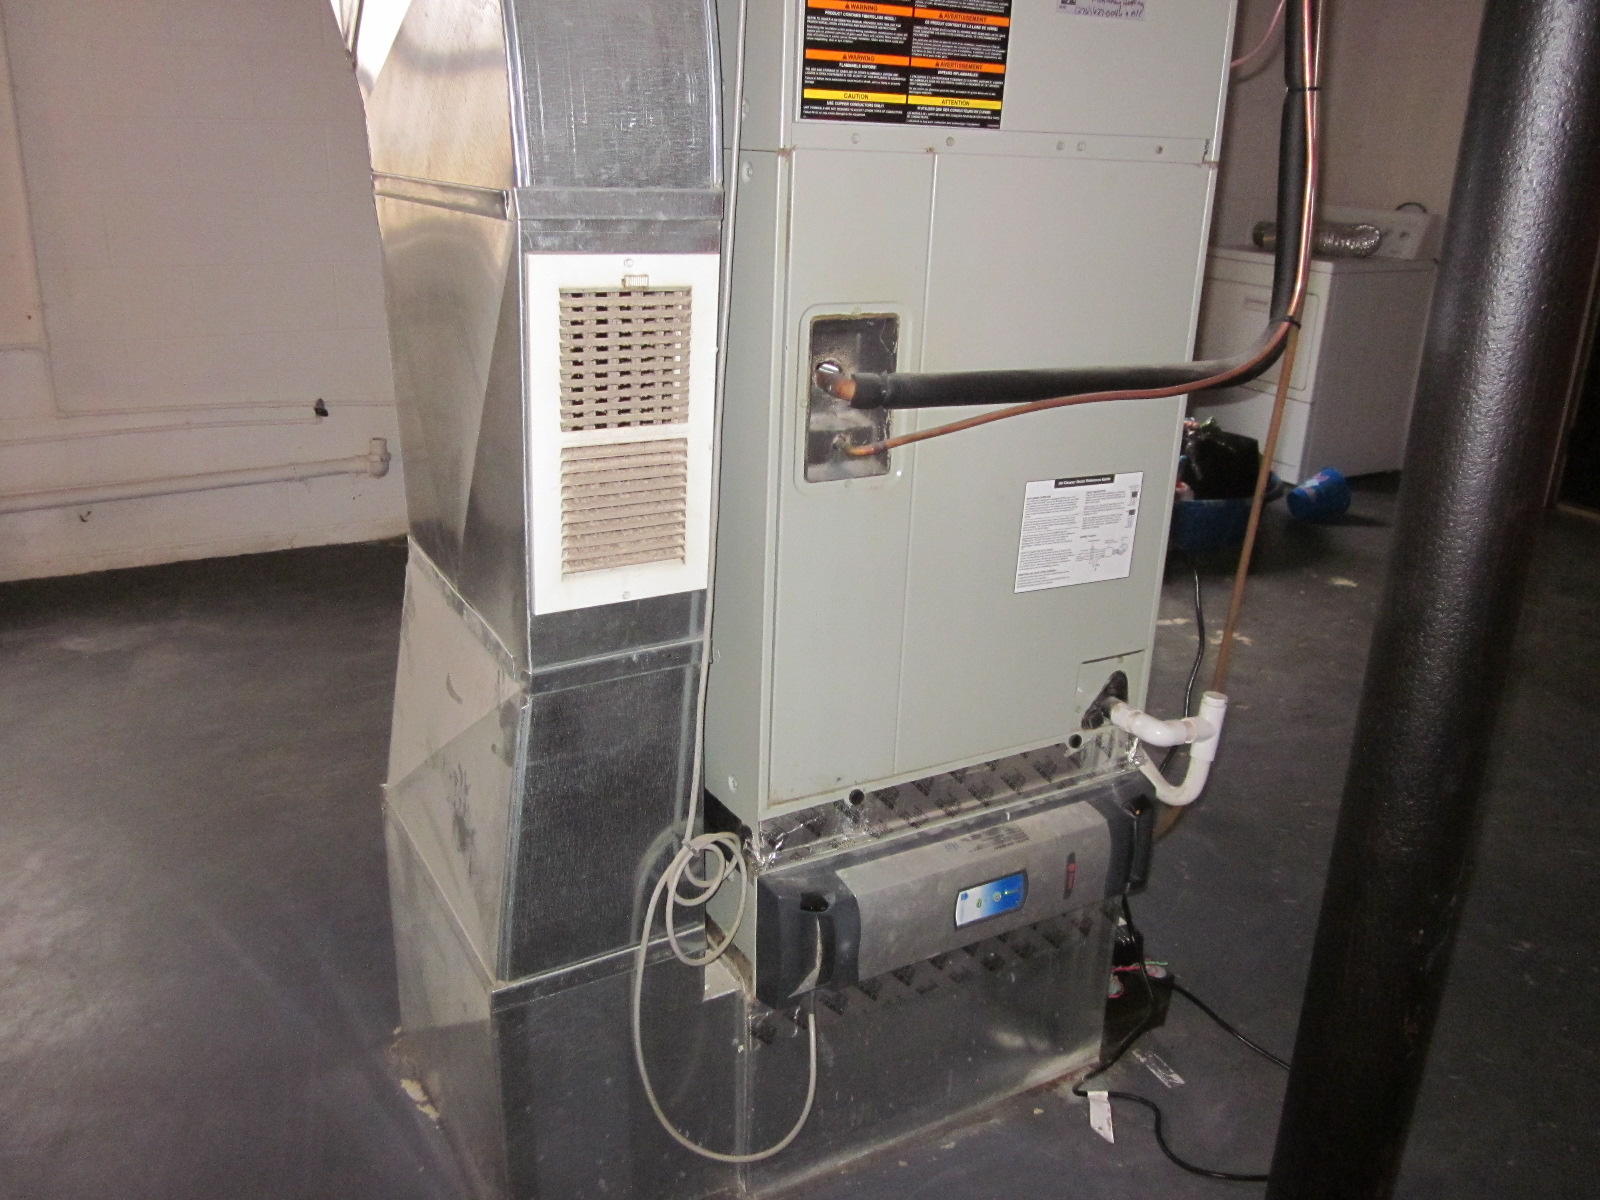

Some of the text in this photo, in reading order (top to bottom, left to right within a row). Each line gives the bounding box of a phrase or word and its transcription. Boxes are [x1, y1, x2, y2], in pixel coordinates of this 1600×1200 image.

[850, 3, 878, 11] WARNING
[944, 12, 987, 22] AVERTISSEMENT
[848, 54, 875, 62] WARNING
[939, 62, 983, 70] AVERTISSEMENT
[843, 92, 869, 100] CAUTION
[941, 98, 970, 106] ATTENTION
